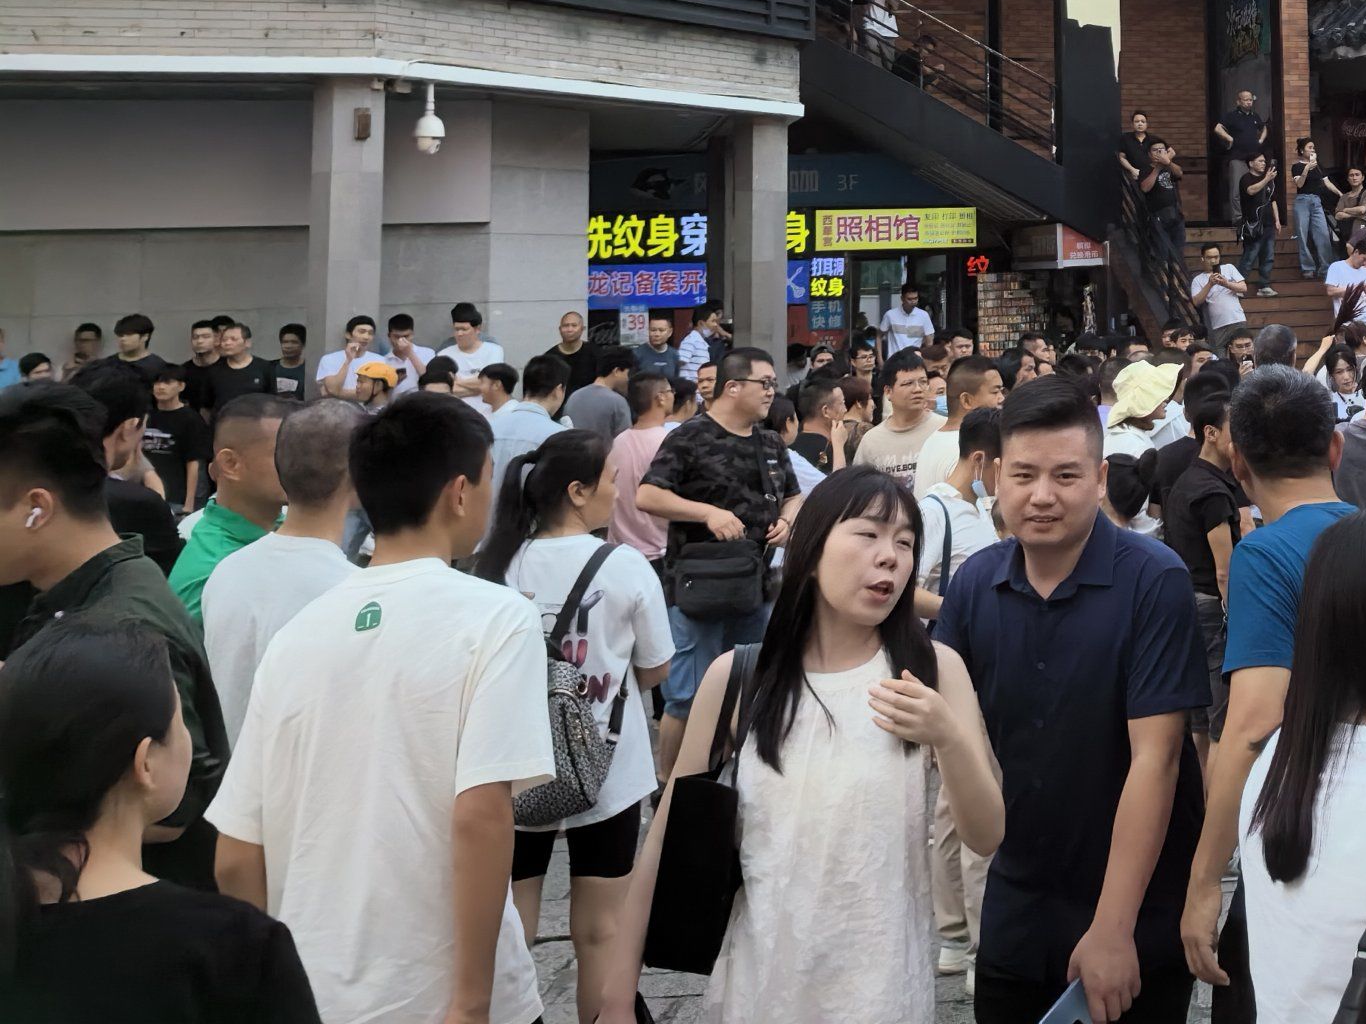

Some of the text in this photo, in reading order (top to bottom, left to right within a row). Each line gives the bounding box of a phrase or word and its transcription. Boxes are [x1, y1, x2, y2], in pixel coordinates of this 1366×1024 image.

[836, 214, 921, 243] 照相馆
[811, 258, 844, 276] 打耳洞
[811, 278, 844, 296] 纹身
[812, 301, 841, 313] 手机
[812, 316, 841, 328] 快修
